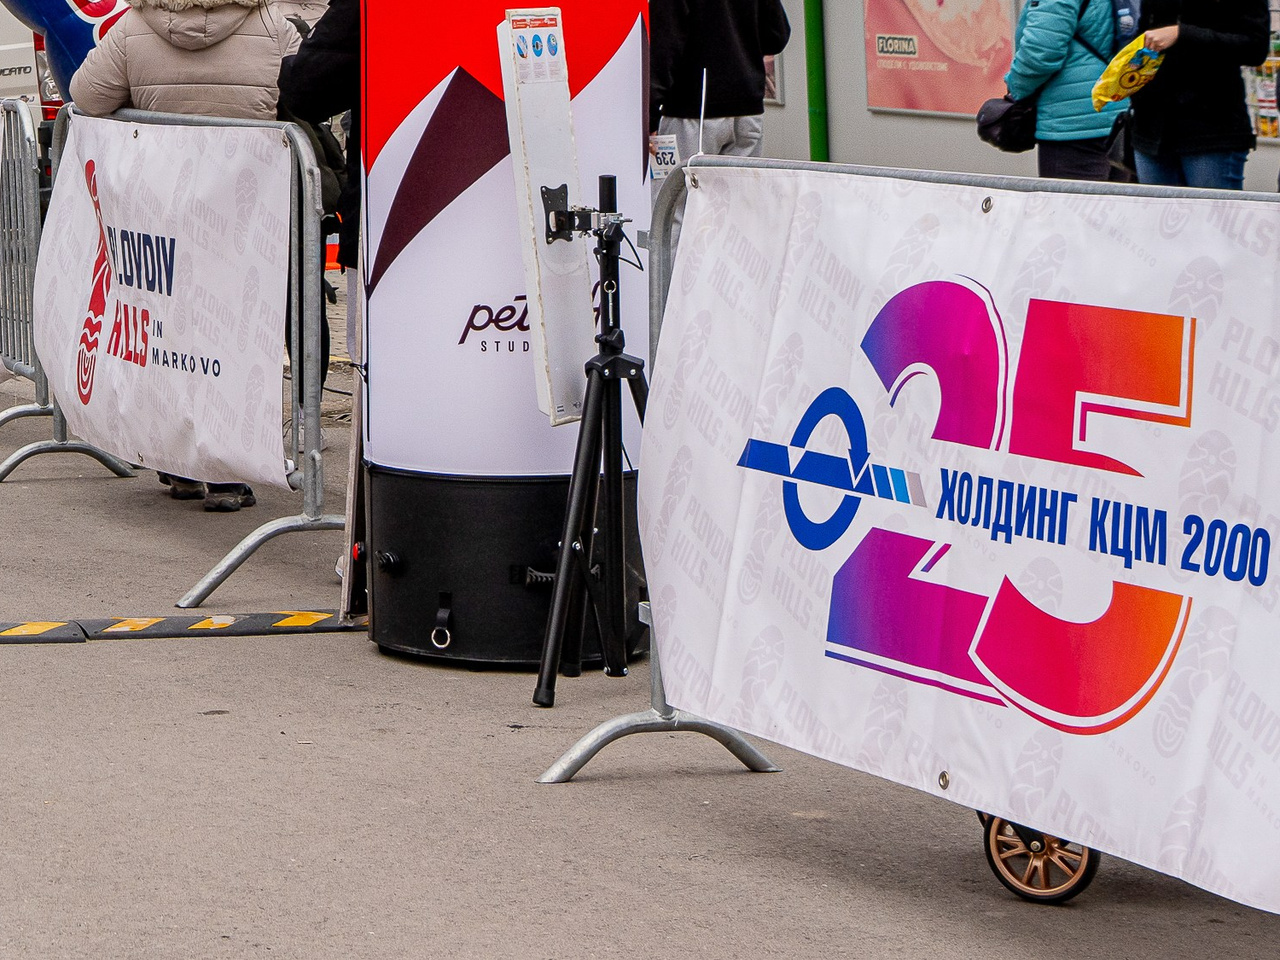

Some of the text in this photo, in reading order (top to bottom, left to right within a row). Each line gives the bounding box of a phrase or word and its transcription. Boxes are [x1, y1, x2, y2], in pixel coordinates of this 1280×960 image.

[877, 36, 917, 55] FLORINA
[655, 152, 676, 166] 239
[106, 226, 176, 297] PLOVDIV
[152, 320, 163, 339] IN
[481, 341, 530, 352] STUD
[152, 346, 222, 378] MARKOVO
[935, 467, 1272, 588] ХОЛДИНГ КЦМ 2000
